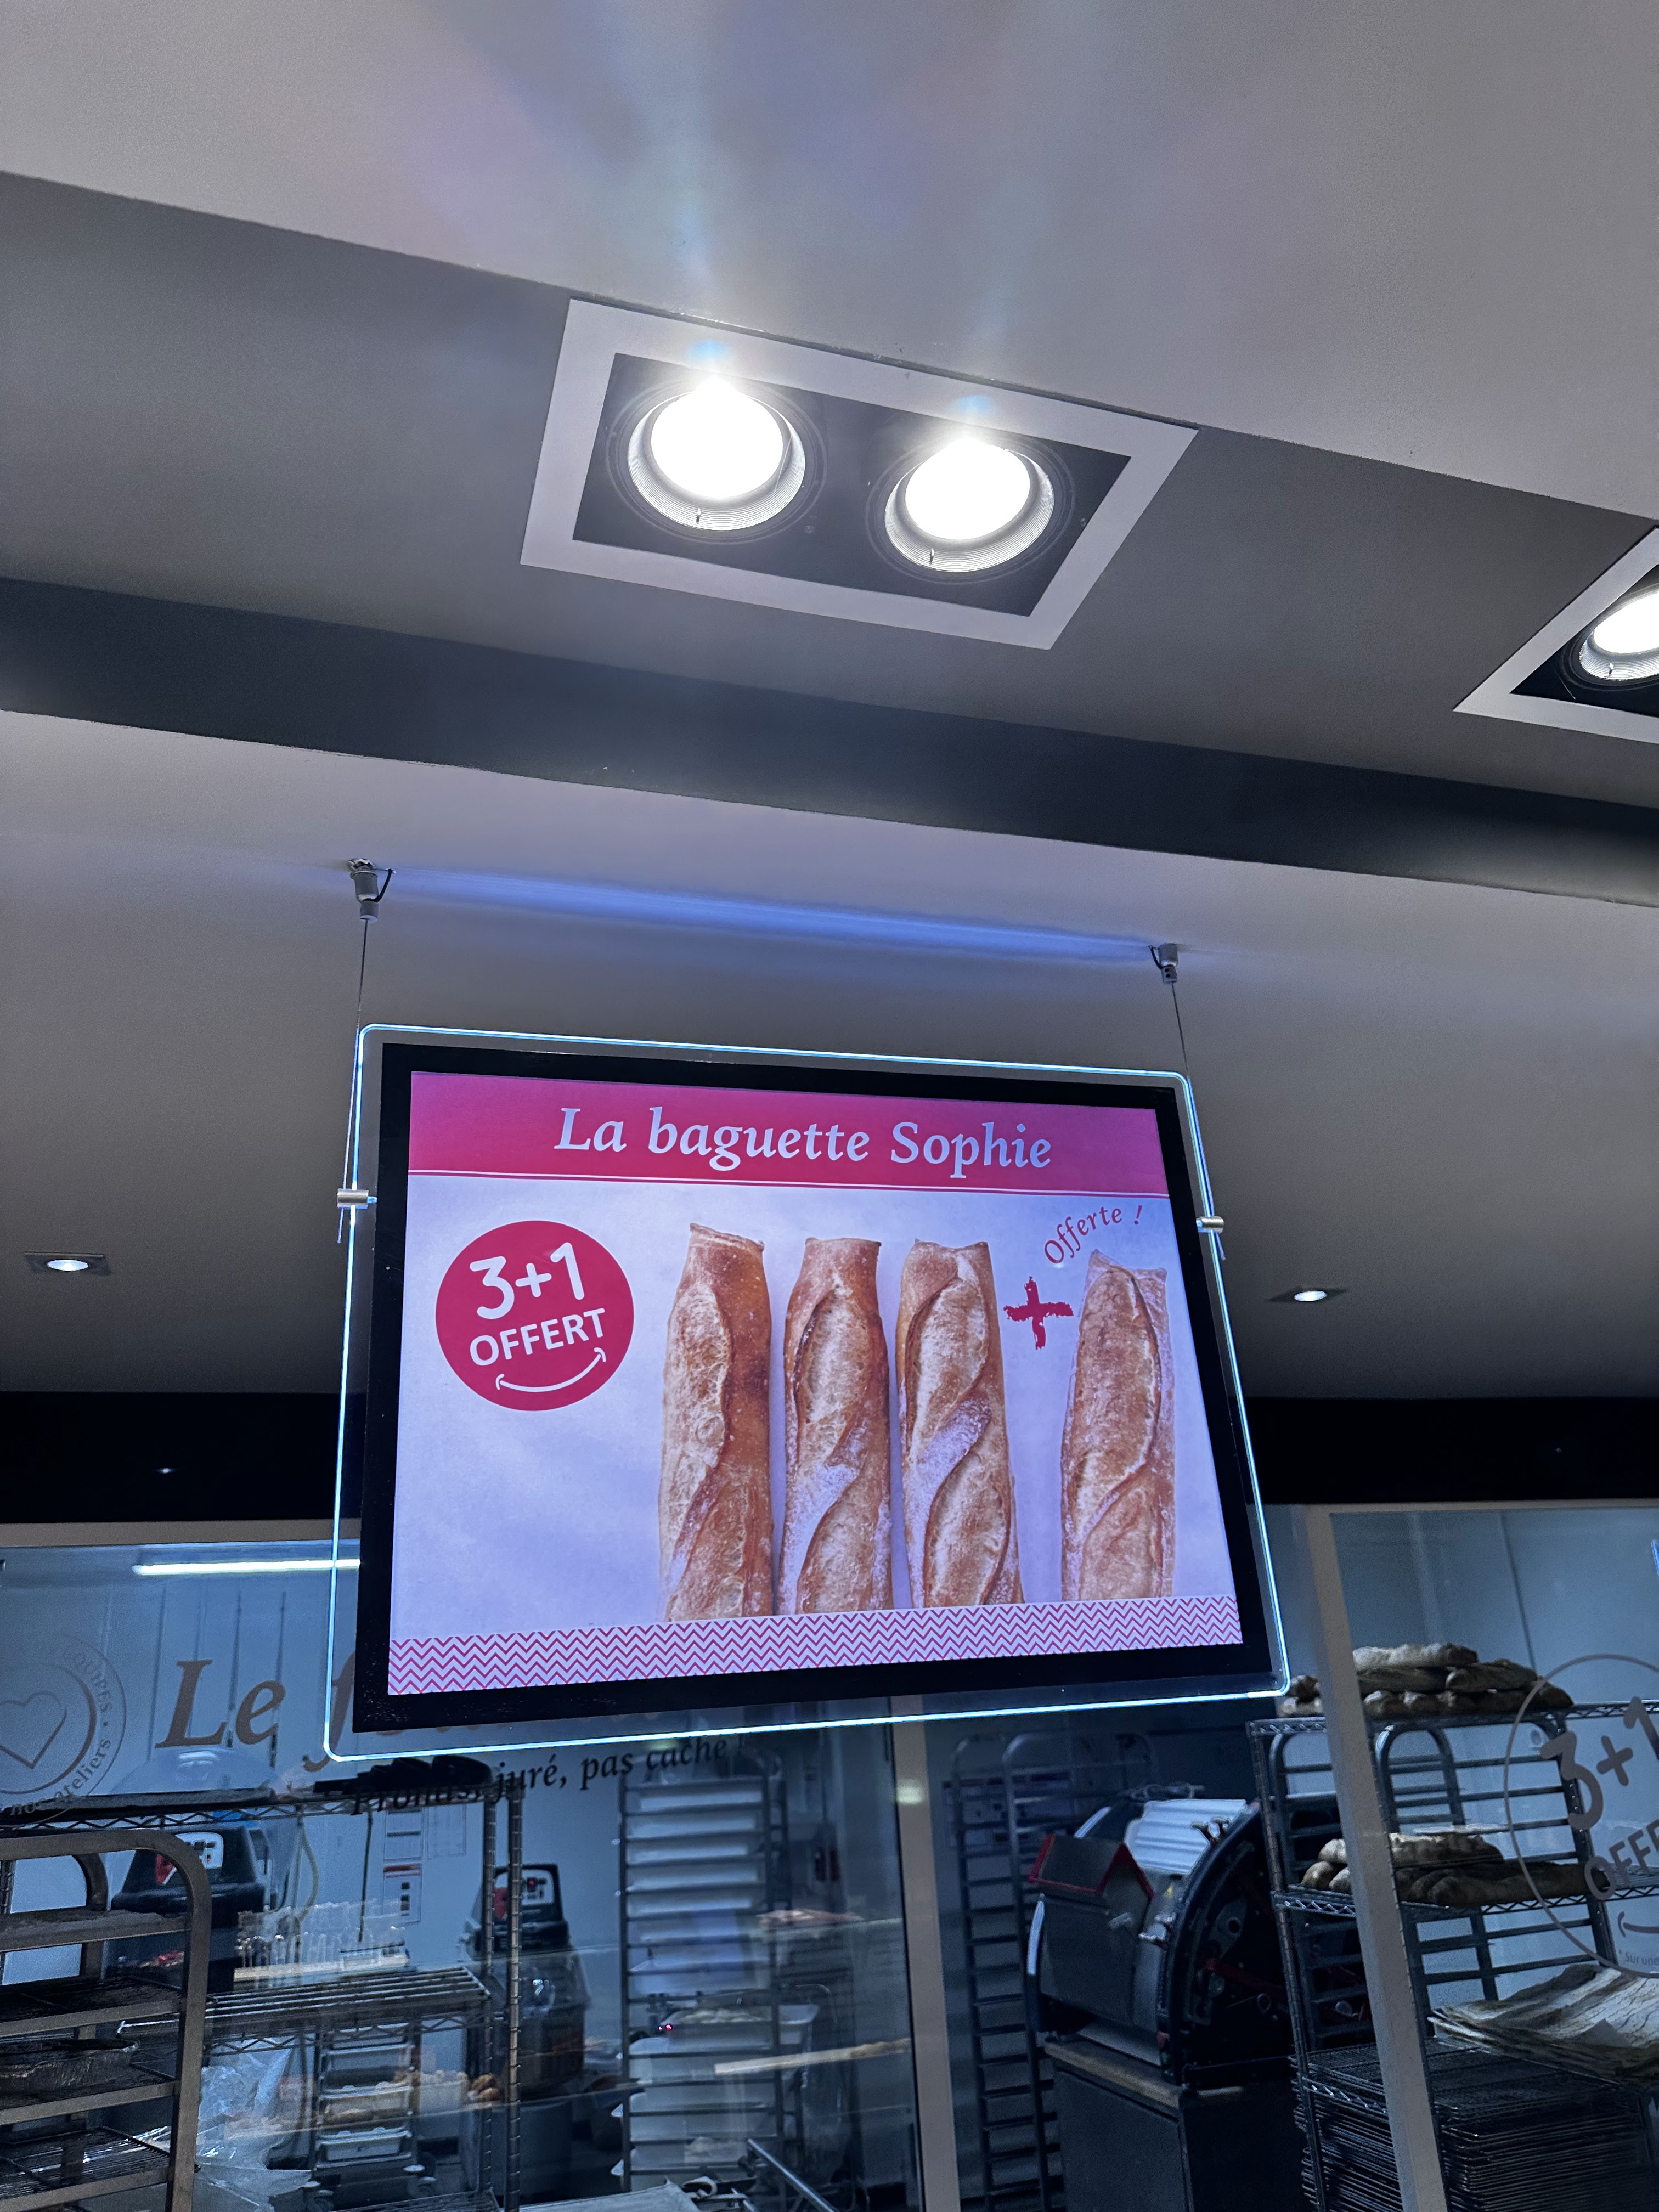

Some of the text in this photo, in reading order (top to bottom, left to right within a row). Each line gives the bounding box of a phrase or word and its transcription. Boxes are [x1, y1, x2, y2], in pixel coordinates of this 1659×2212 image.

[554, 1106, 1052, 1179] La baguette Sophie
[1044, 1205, 1143, 1264] Offerte !
[469, 1242, 585, 1320] 3+1
[469, 1307, 606, 1367] OFFERT
[154, 1658, 286, 1748] Le
[490, 1753, 567, 1805] juré,
[579, 1752, 634, 1791] pas
[1624, 1951, 1640, 1964] Sur
